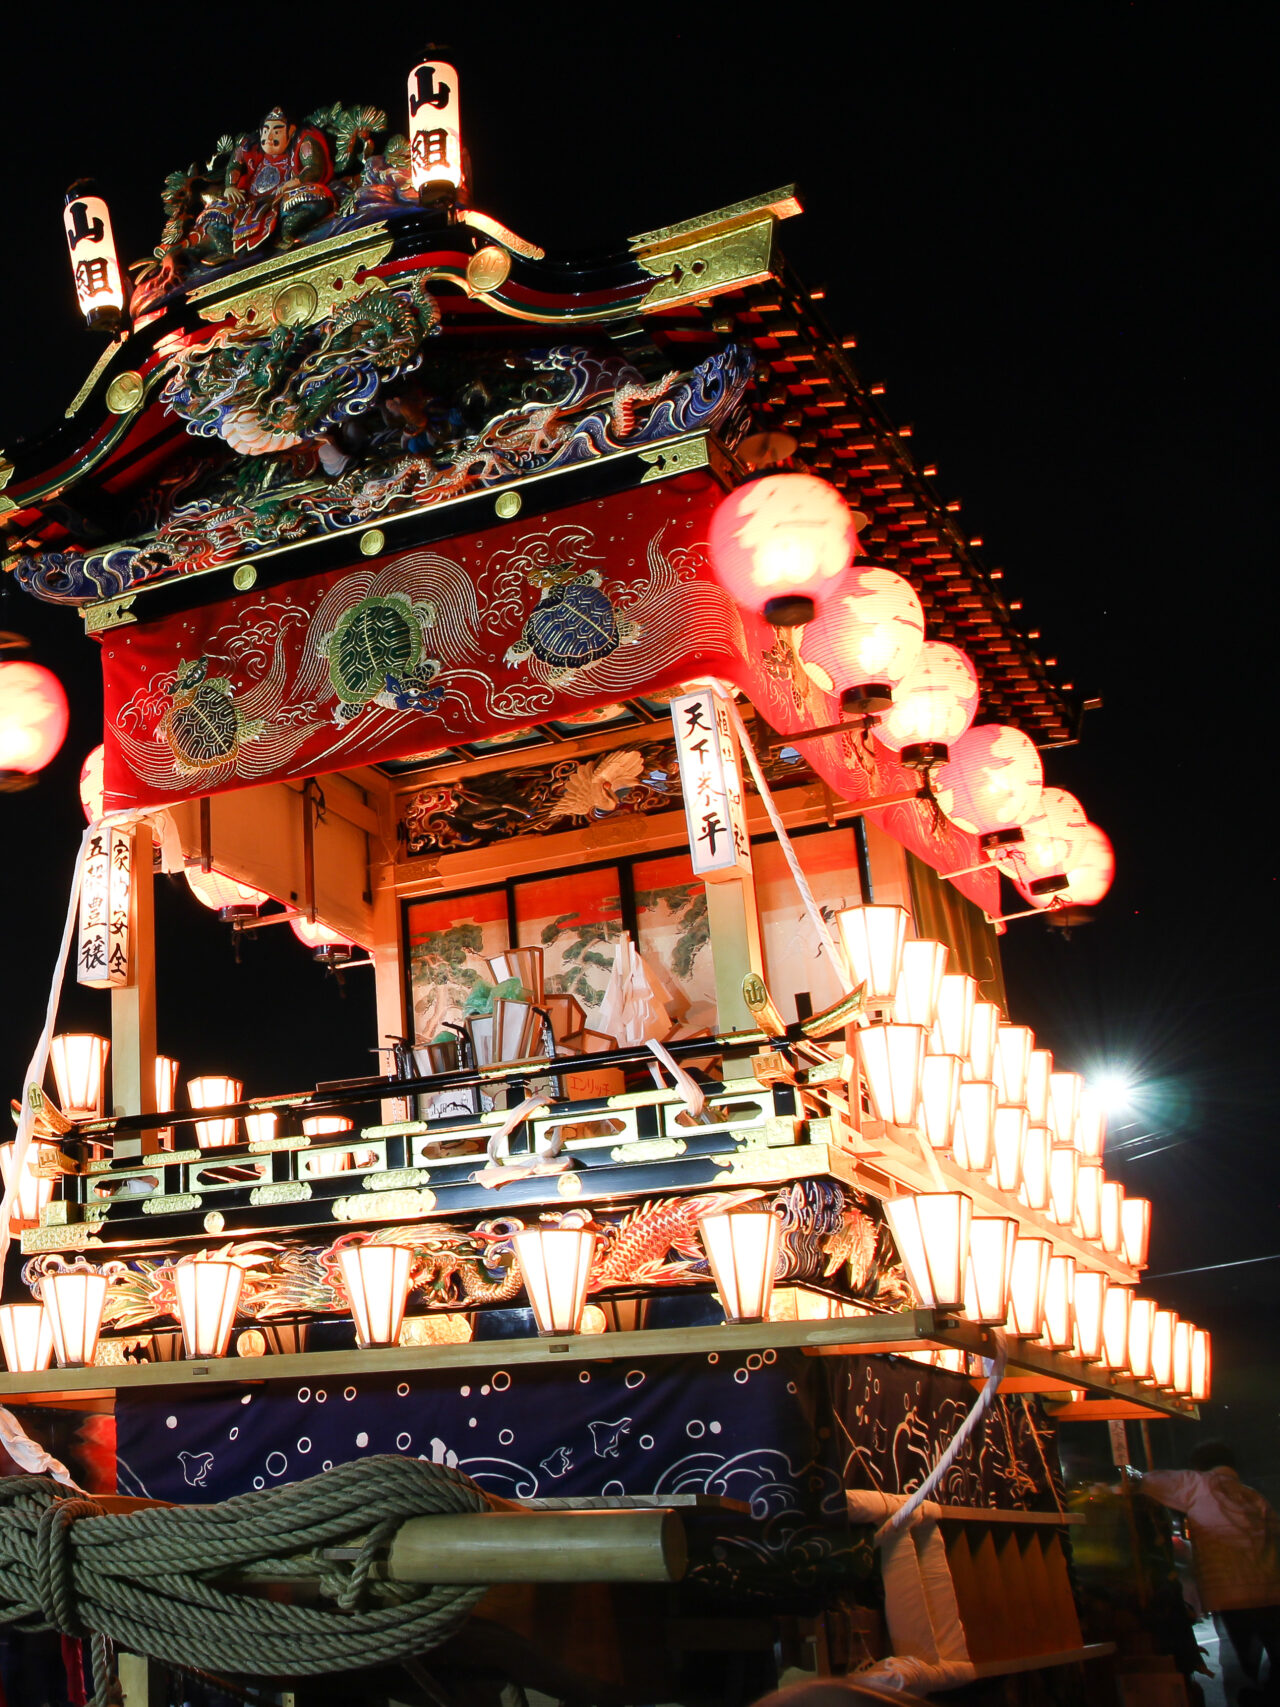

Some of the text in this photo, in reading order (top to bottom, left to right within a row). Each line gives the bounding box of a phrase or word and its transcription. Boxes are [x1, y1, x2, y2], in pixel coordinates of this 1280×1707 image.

[410, 66, 451, 177] 山組
[68, 202, 113, 302] 山組
[683, 702, 727, 857] 天下泰平
